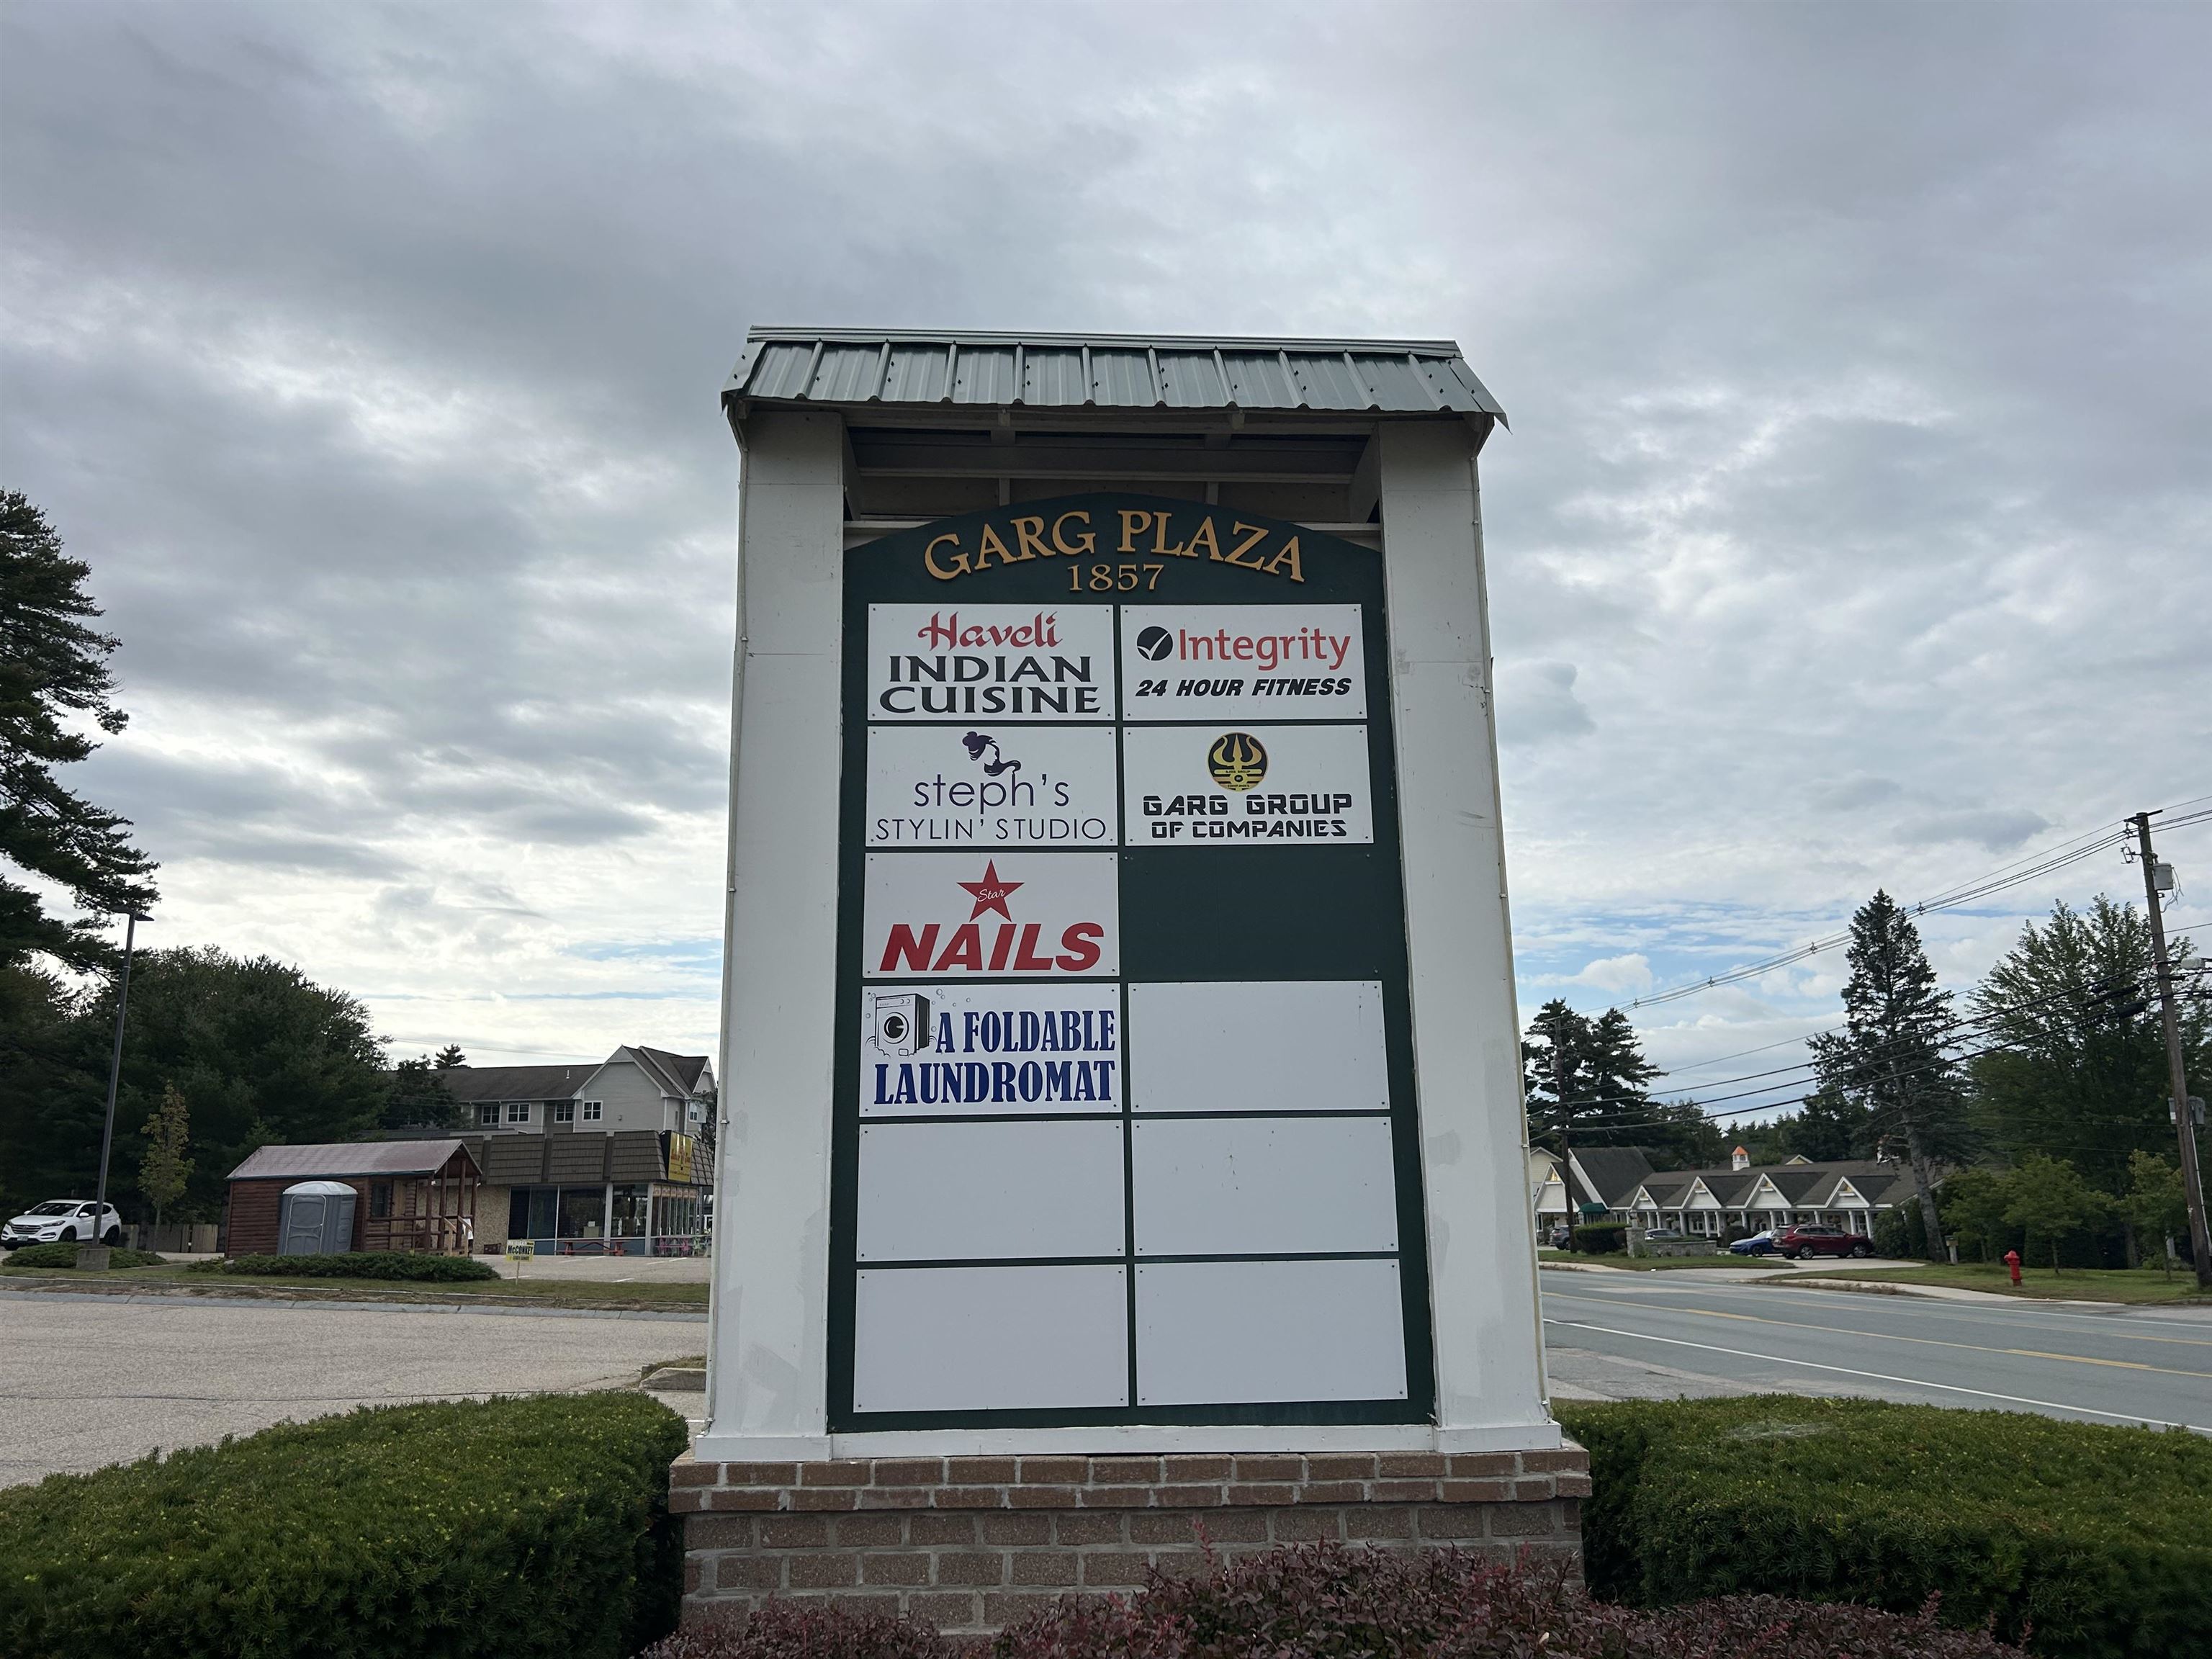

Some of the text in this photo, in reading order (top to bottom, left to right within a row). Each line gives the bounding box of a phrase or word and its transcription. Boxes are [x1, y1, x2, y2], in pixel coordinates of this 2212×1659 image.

[924, 510, 1305, 583] GARG PLAZA
[1069, 563, 1164, 592] 1857
[918, 611, 1064, 652] Haveli
[1179, 626, 1351, 671] Integrity
[889, 655, 1092, 683] INDIAN
[879, 686, 1101, 714] CUISINE
[1136, 678, 1352, 697] 24 HOUR FITNESS
[914, 773, 1070, 815] steph's
[1143, 793, 1352, 816] GARG GROUP
[876, 817, 1107, 841] STYLIN' STUDIO
[1151, 819, 1347, 839] OF COMPANIES
[978, 889, 1006, 902] Star
[879, 922, 1105, 972] NAILS
[935, 1010, 1115, 1053] A FOLDABLE
[873, 1060, 1115, 1105] LAUNDROMAT
